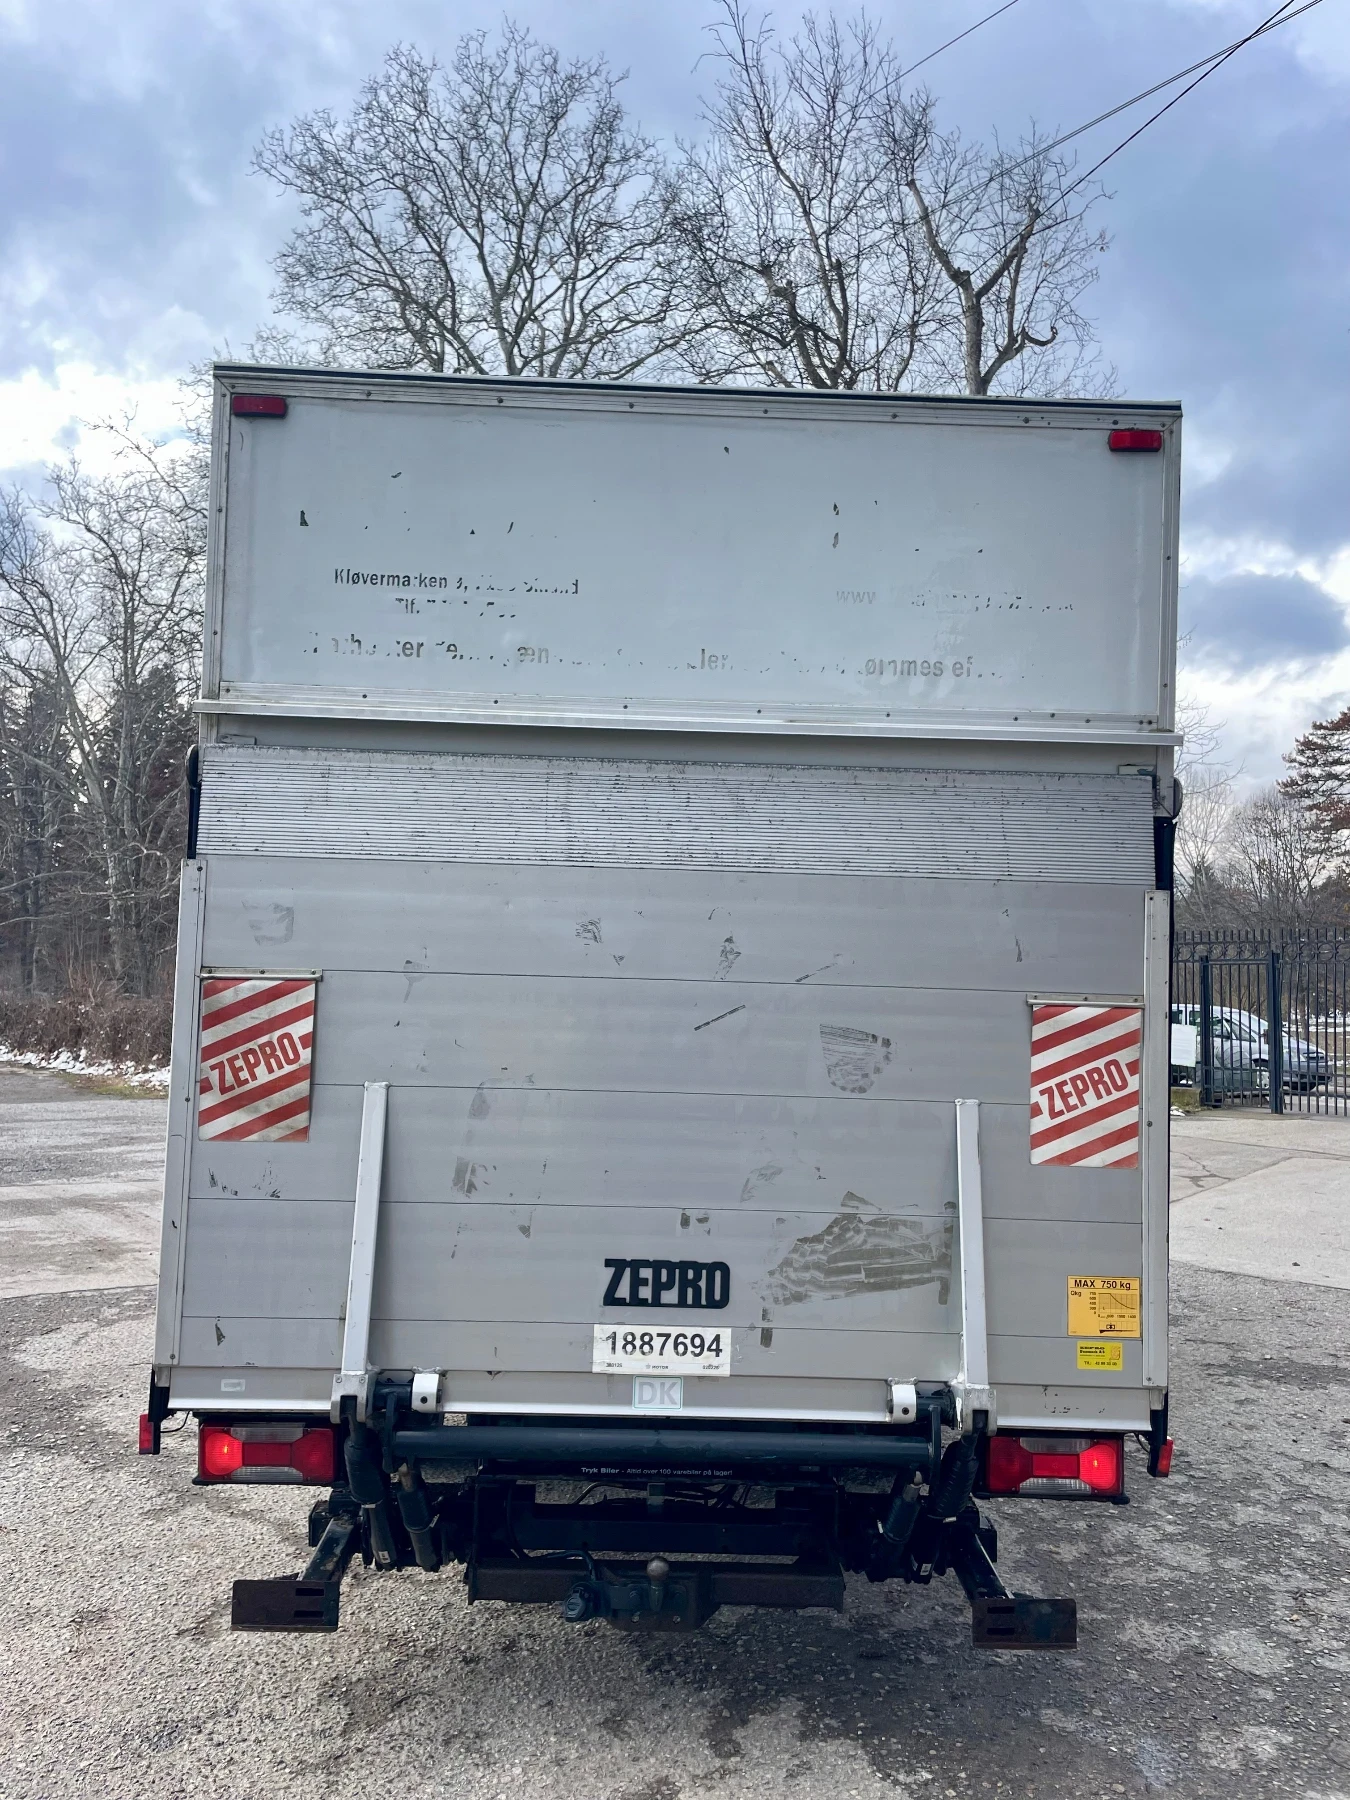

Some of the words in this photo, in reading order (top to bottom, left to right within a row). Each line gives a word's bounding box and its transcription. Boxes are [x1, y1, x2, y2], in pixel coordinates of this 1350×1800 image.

[208, 1031, 302, 1096] ZEPRO
[1038, 1057, 1129, 1121] ZEPRO
[602, 1258, 731, 1309] ZEPRO
[1074, 1279, 1096, 1288] MAX
[1100, 1280, 1117, 1289] 750
[1119, 1281, 1131, 1291] kg
[605, 1331, 723, 1358] 1887694
[637, 1381, 680, 1405] DK
[580, 1467, 599, 1475] Tryk
[702, 1468, 712, 1477] på
[713, 1469, 733, 1477] lager!
